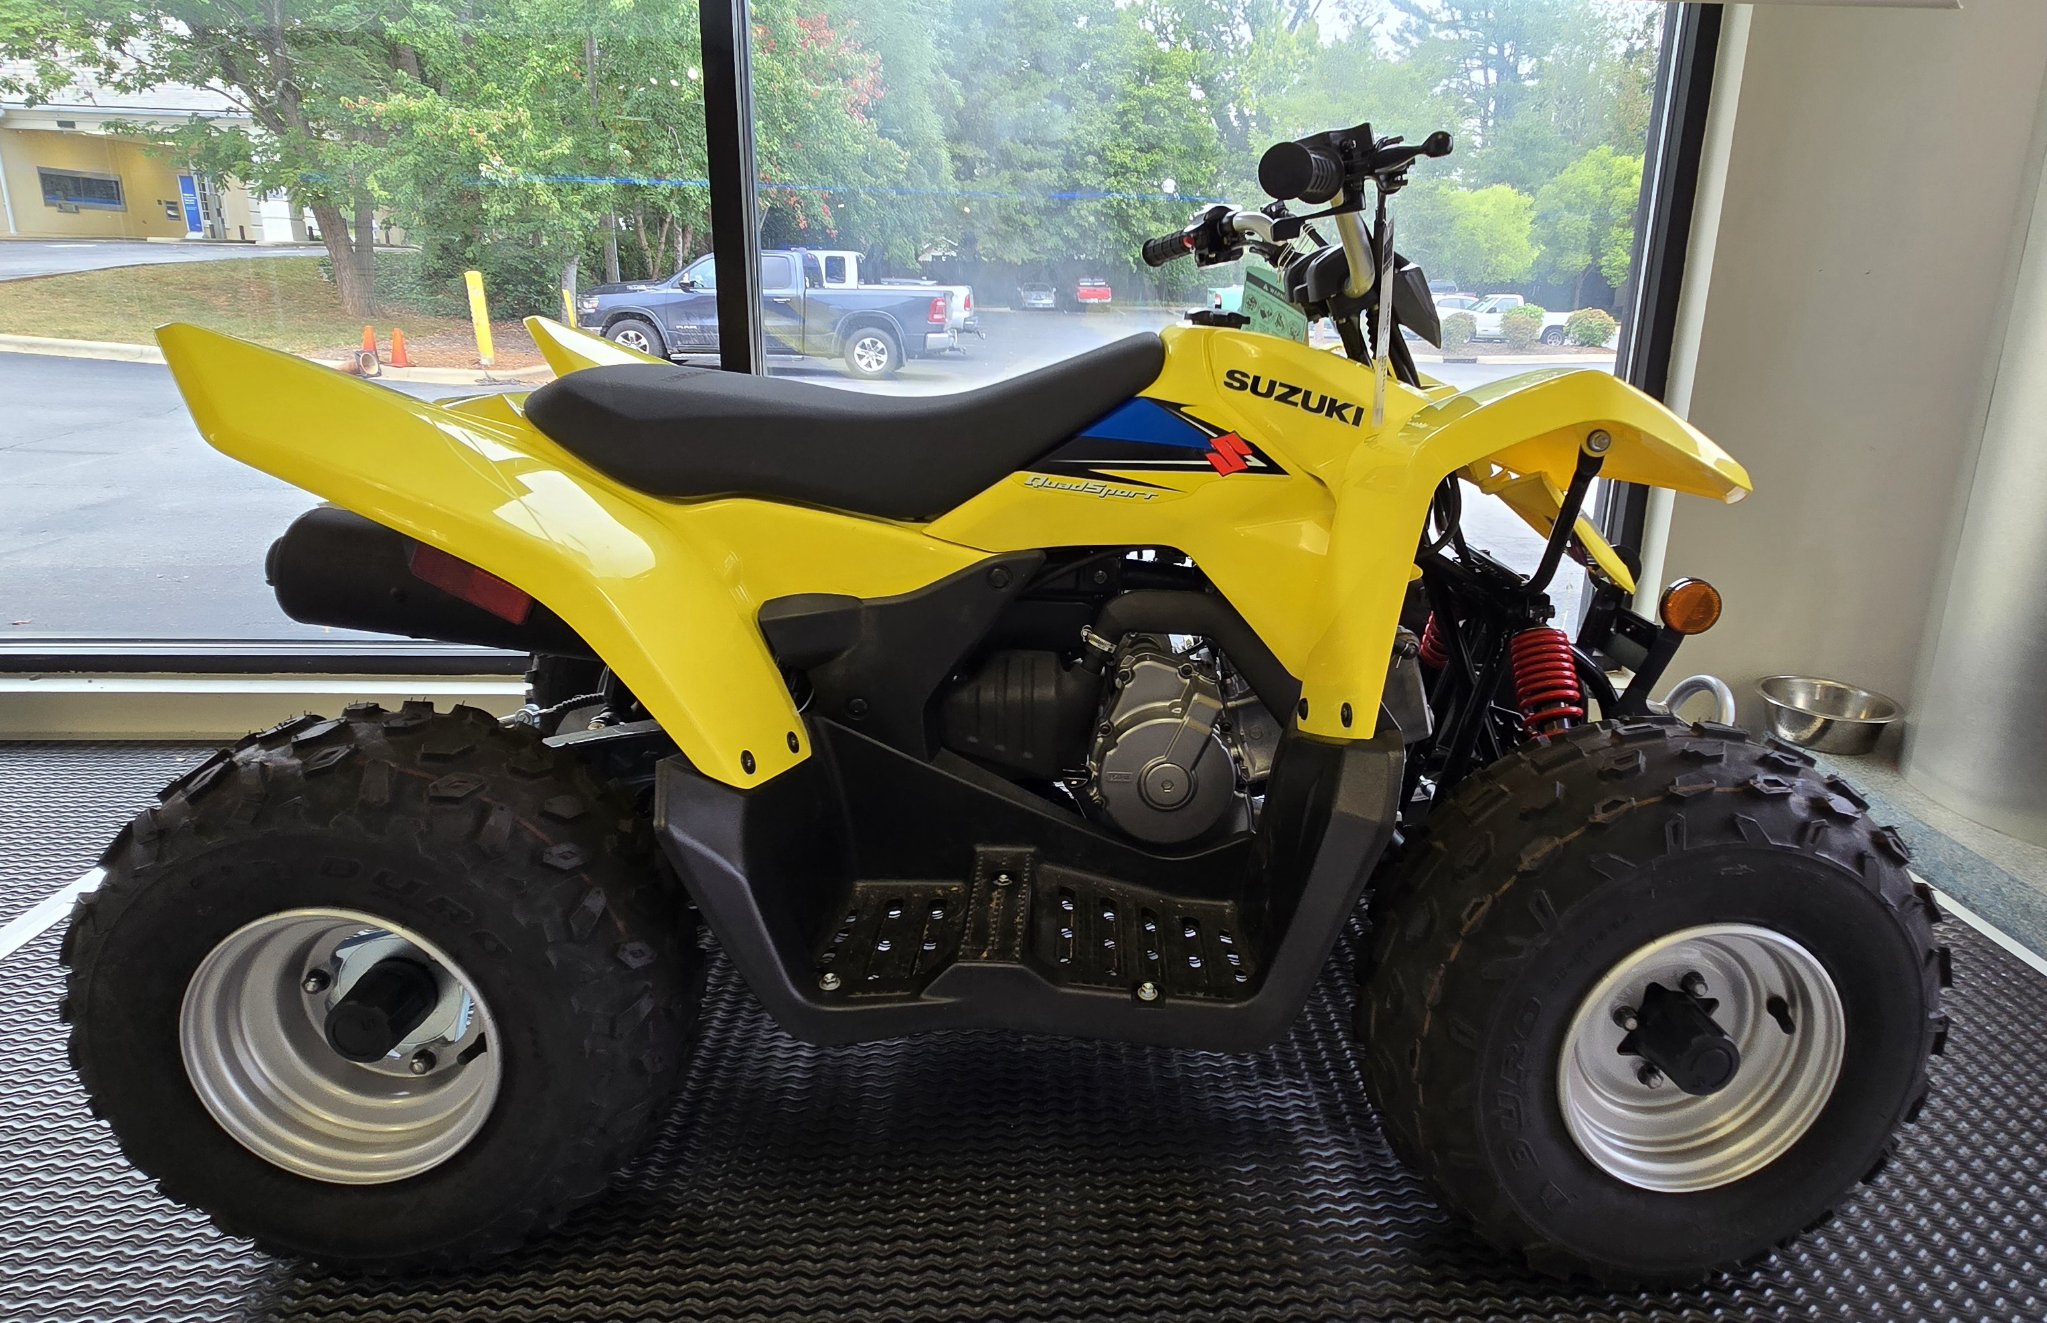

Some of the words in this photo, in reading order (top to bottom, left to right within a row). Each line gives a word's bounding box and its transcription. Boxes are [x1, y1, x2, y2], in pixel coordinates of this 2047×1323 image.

[1223, 369, 1365, 427] SUZUKI
[1024, 474, 1160, 502] QuadSport
[317, 854, 514, 959] DURO
